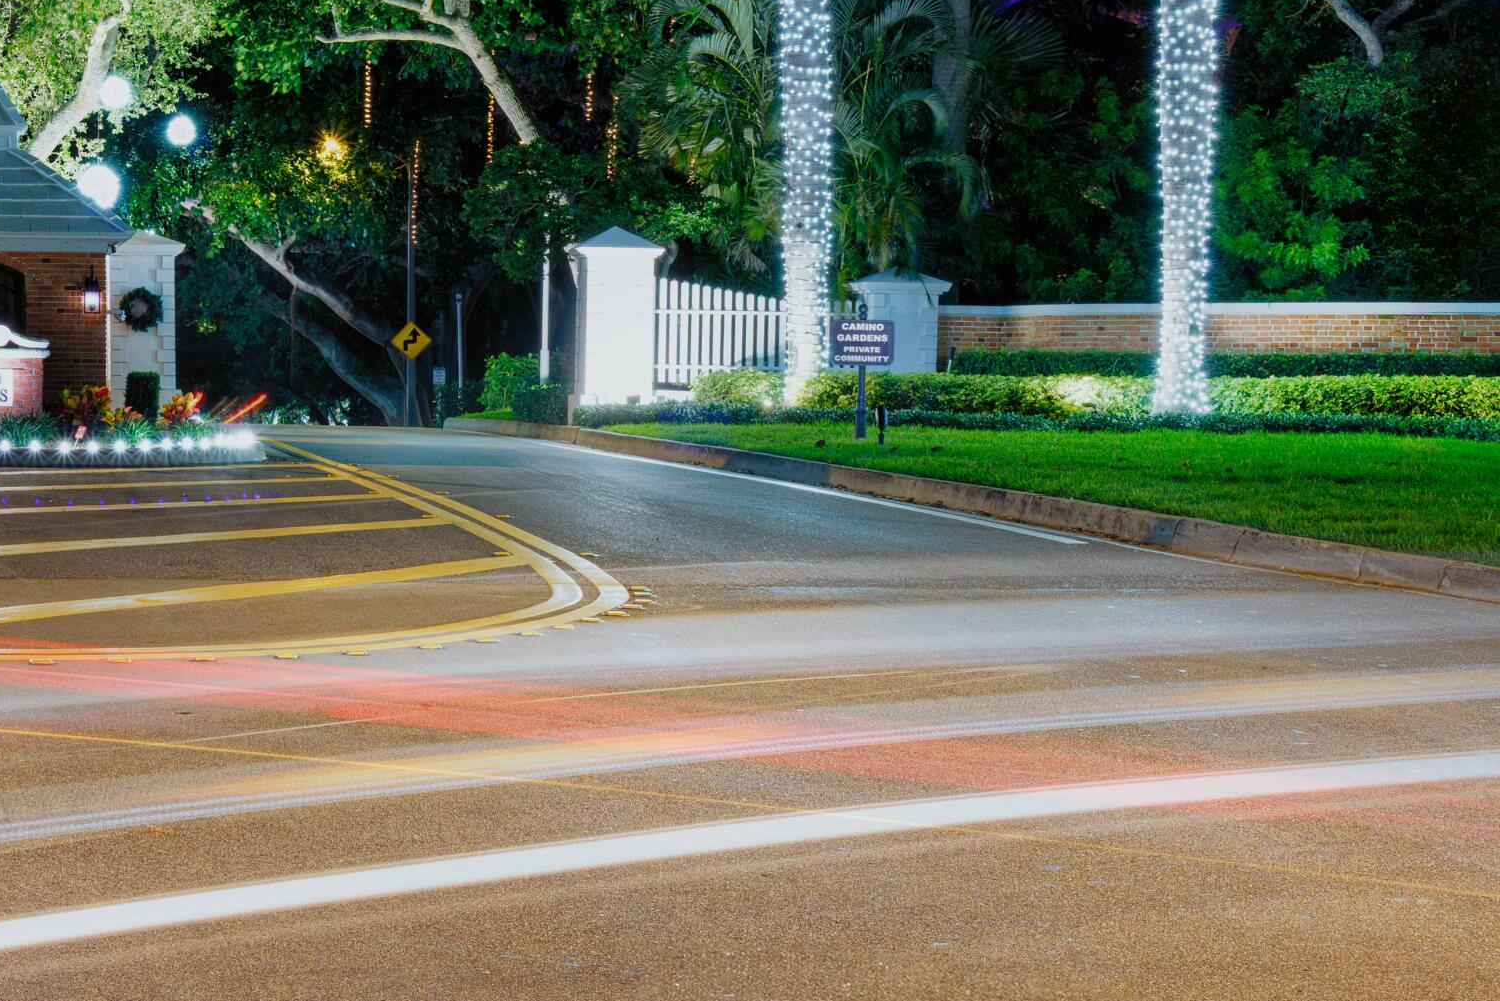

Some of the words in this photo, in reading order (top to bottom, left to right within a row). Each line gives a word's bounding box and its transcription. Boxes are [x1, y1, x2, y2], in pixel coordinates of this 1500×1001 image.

[841, 322, 884, 331] CAMINO
[836, 333, 888, 342] GARDENS
[843, 345, 881, 353] PRIVATE
